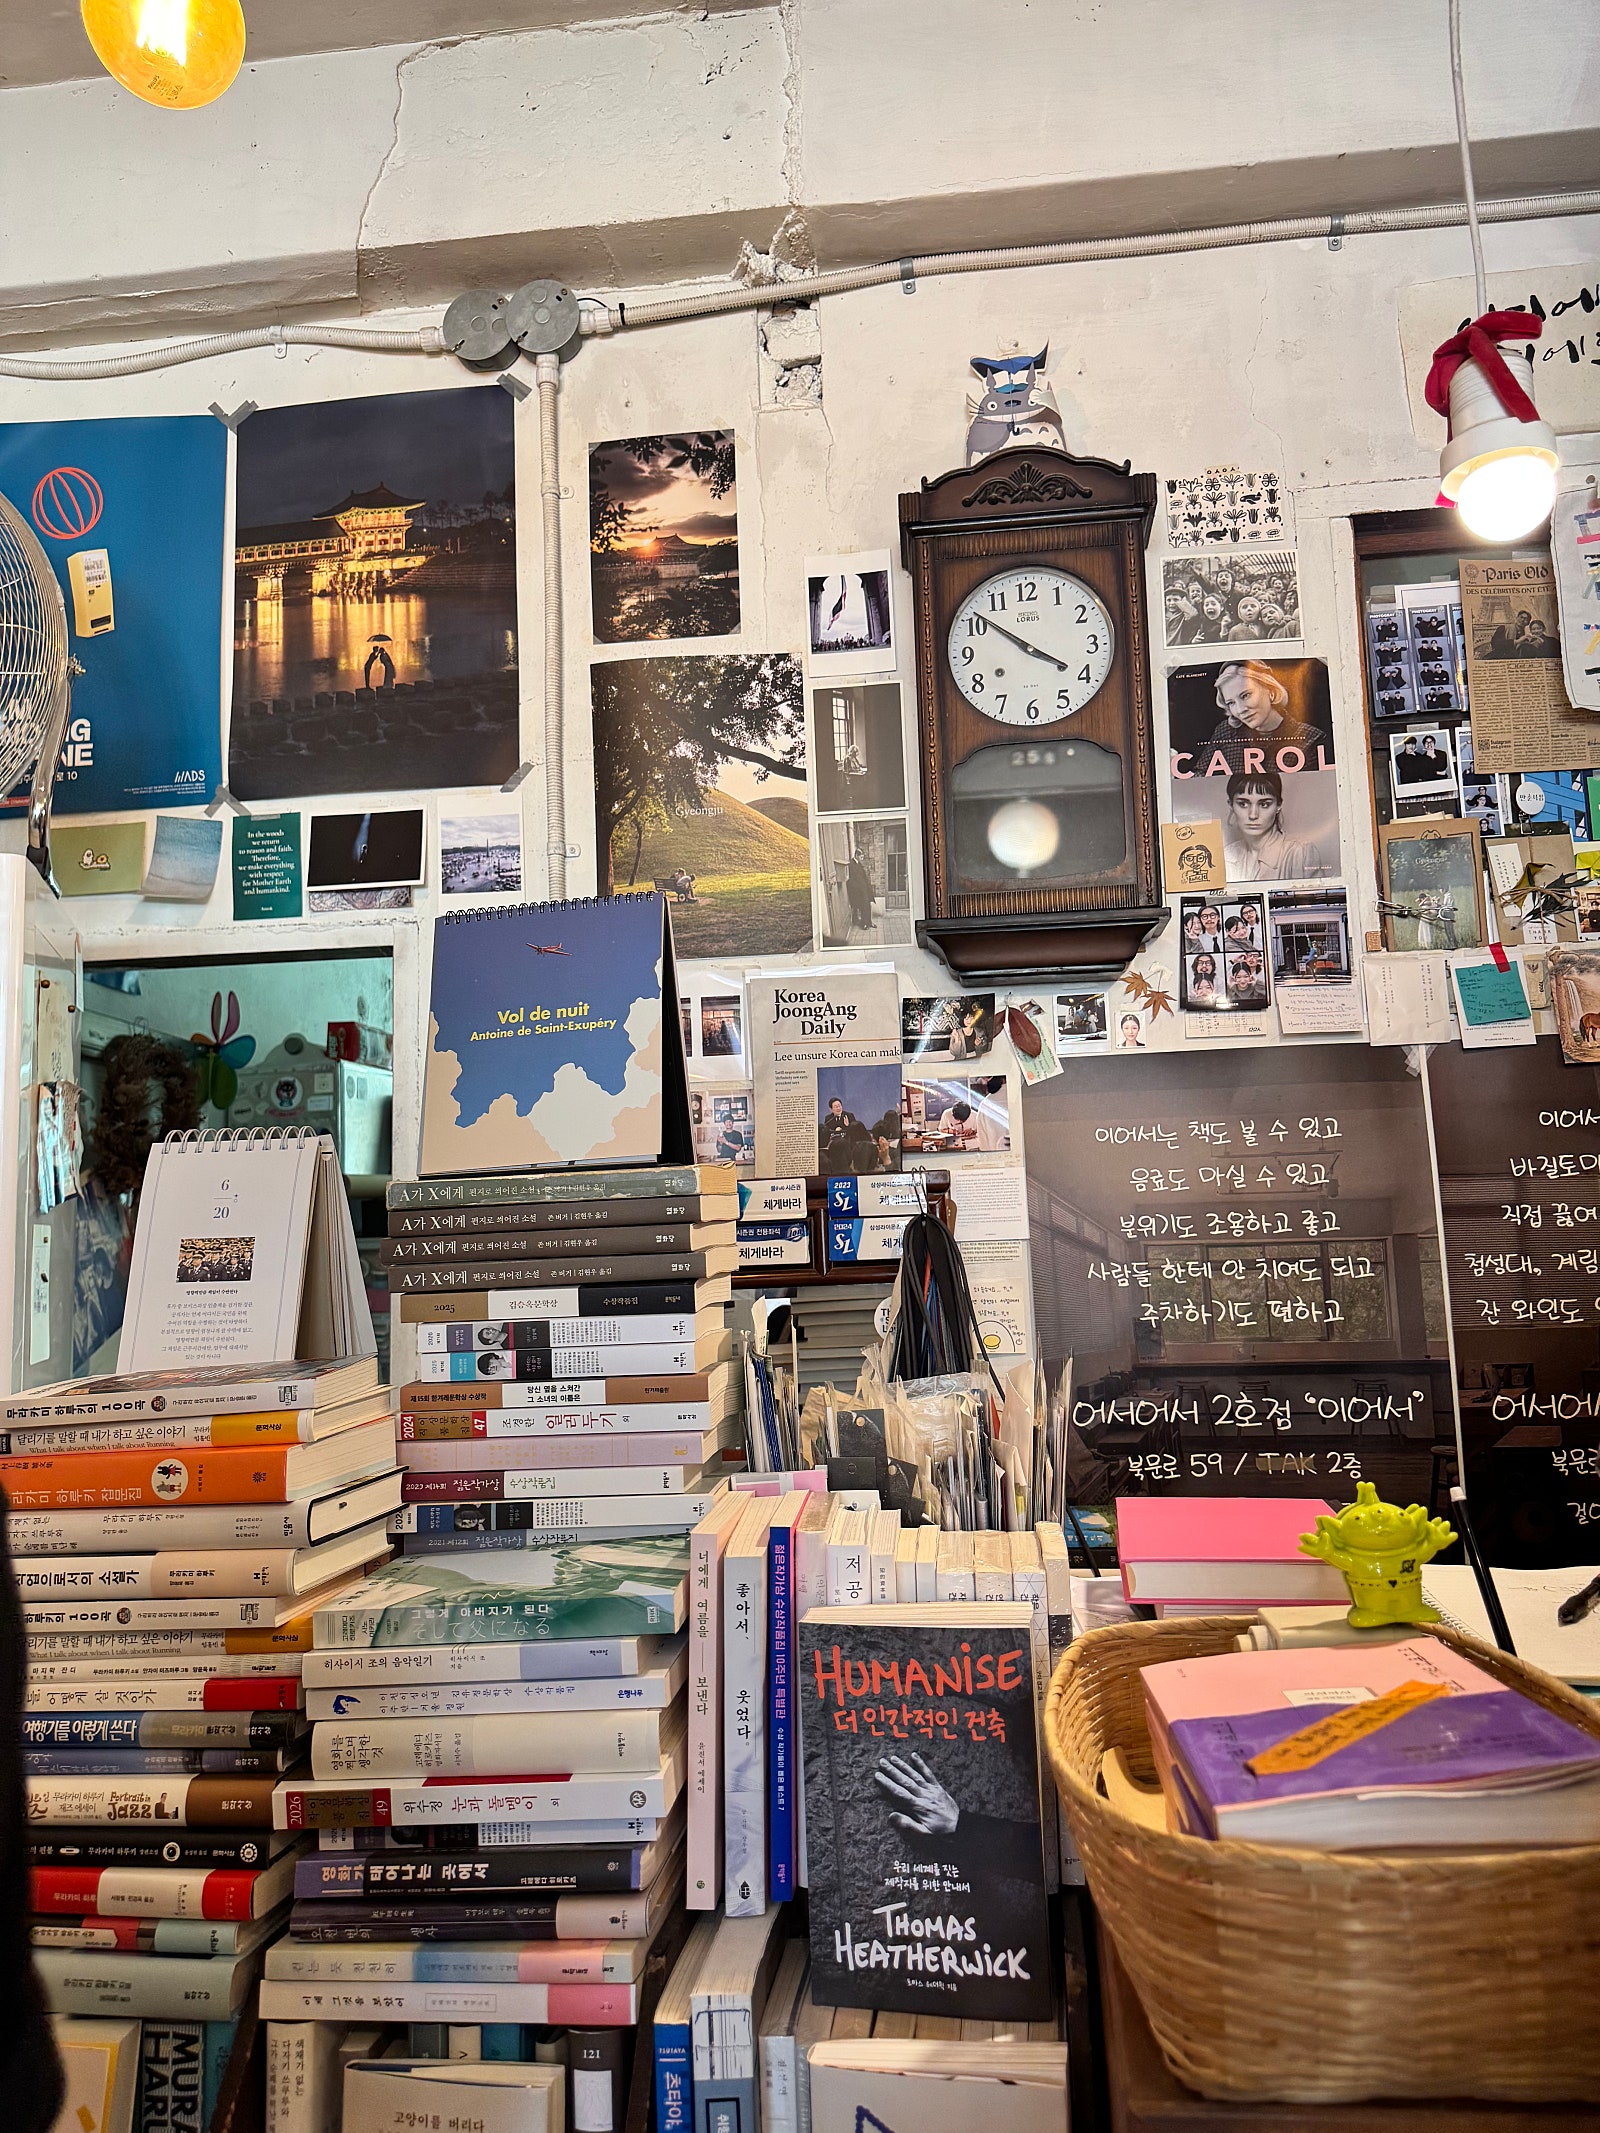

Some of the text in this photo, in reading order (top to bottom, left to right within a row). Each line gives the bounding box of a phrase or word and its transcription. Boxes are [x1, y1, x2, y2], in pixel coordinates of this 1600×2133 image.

[1482, 565, 1549, 584] Paris Old
[1015, 581, 1039, 603] 12
[1052, 587, 1062, 607] 1
[1519, 587, 1534, 595] ONT
[988, 592, 1008, 612] 11
[1016, 615, 1040, 624] LORUS
[1074, 604, 1089, 624] 2
[966, 616, 988, 637] 10
[1086, 634, 1099, 655] 3
[961, 646, 975, 667] 9
[971, 673, 985, 694] 8
[1078, 664, 1092, 684] 4
[995, 694, 1008, 714] 7
[1026, 698, 1039, 720] 6
[1056, 689, 1070, 710] 5
[1170, 744, 1337, 781] CAROL
[675, 805, 723, 818] Gyeongju
[248, 831, 254, 840] In
[255, 830, 265, 839] the
[266, 845, 277, 853] and
[248, 862, 263, 870] make
[264, 860, 295, 870] everything
[249, 870, 284, 879] with respect
[252, 878, 274, 887] Mother
[275, 876, 292, 885] Earth
[244, 888, 255, 896] and
[774, 988, 826, 1005] Korea
[496, 1000, 591, 1026] Vol de nuit
[772, 1002, 857, 1024] JoongAng
[469, 1016, 618, 1043] Antoine de Saint-Exupéry
[800, 1020, 846, 1039] Daily
[774, 1048, 878, 1062] Lee unsure Korea can
[1094, 1116, 1343, 1150] 이어서는 책도 볼 수 있고
[221, 1178, 230, 1192] 6
[834, 1181, 852, 1190] 2023
[1129, 1162, 1331, 1193] 음료도 마실 수 있고
[763, 1197, 802, 1211] 체게바라
[833, 1191, 854, 1213] SL
[212, 1206, 230, 1220] 20
[401, 1213, 466, 1233] A가 X에게
[1500, 1203, 1542, 1228] 직접
[1119, 1209, 1341, 1240] 분위기도 조용하고 좋고
[738, 1245, 785, 1260] 체게바라
[834, 1234, 854, 1255] SL
[1086, 1256, 1376, 1289] 사람들 한테 안 치여도 되고
[1463, 1249, 1598, 1277] 첨성대, 계림
[401, 1269, 468, 1288] A가 X에게
[433, 1303, 456, 1314] 2025
[508, 1297, 559, 1311] 김승옥문학상
[1139, 1297, 1345, 1330] 주차하기도 편하고
[1475, 1298, 1585, 1326] 잔 와인도
[6, 1398, 146, 1420] 무라카미 하루키의 100곡
[1071, 1398, 1200, 1428] 어서어서
[1211, 1390, 1292, 1431] 2호점
[17, 1424, 186, 1447] 달리기를 말할 때 내가 하고 싶은 이야기
[1127, 1450, 1363, 1482] 북문로 59 TAK 2층
[405, 1475, 556, 1493] 2023 젊은작가상 수상작품집
[459, 1602, 550, 1618] 아버지가 된다
[411, 1617, 552, 1641] そして父になる
[695, 1550, 710, 1716] 너에게 여름을 보낸다
[774, 1544, 787, 1720] 젊은작가상 수상작품집 10주년 특별판
[323, 1653, 434, 1671] 히사이시 조의 음악일기
[22, 1719, 138, 1743] 여행기를 이렇게 쓴다
[832, 1704, 1007, 1744] 더 인간적인 건축
[451, 1795, 538, 1813] 눈과 돌멩이
[321, 1862, 490, 1883] 영화가 태어나는 곳에서
[892, 1860, 960, 1879] 우리 세계를 짓는
[883, 1876, 972, 1894] 제작자를 위한 안내서
[872, 1901, 977, 1943] THOMAS
[658, 2047, 686, 2055] TSUTAYA
[393, 2111, 486, 2133] 고양이를 버리다
